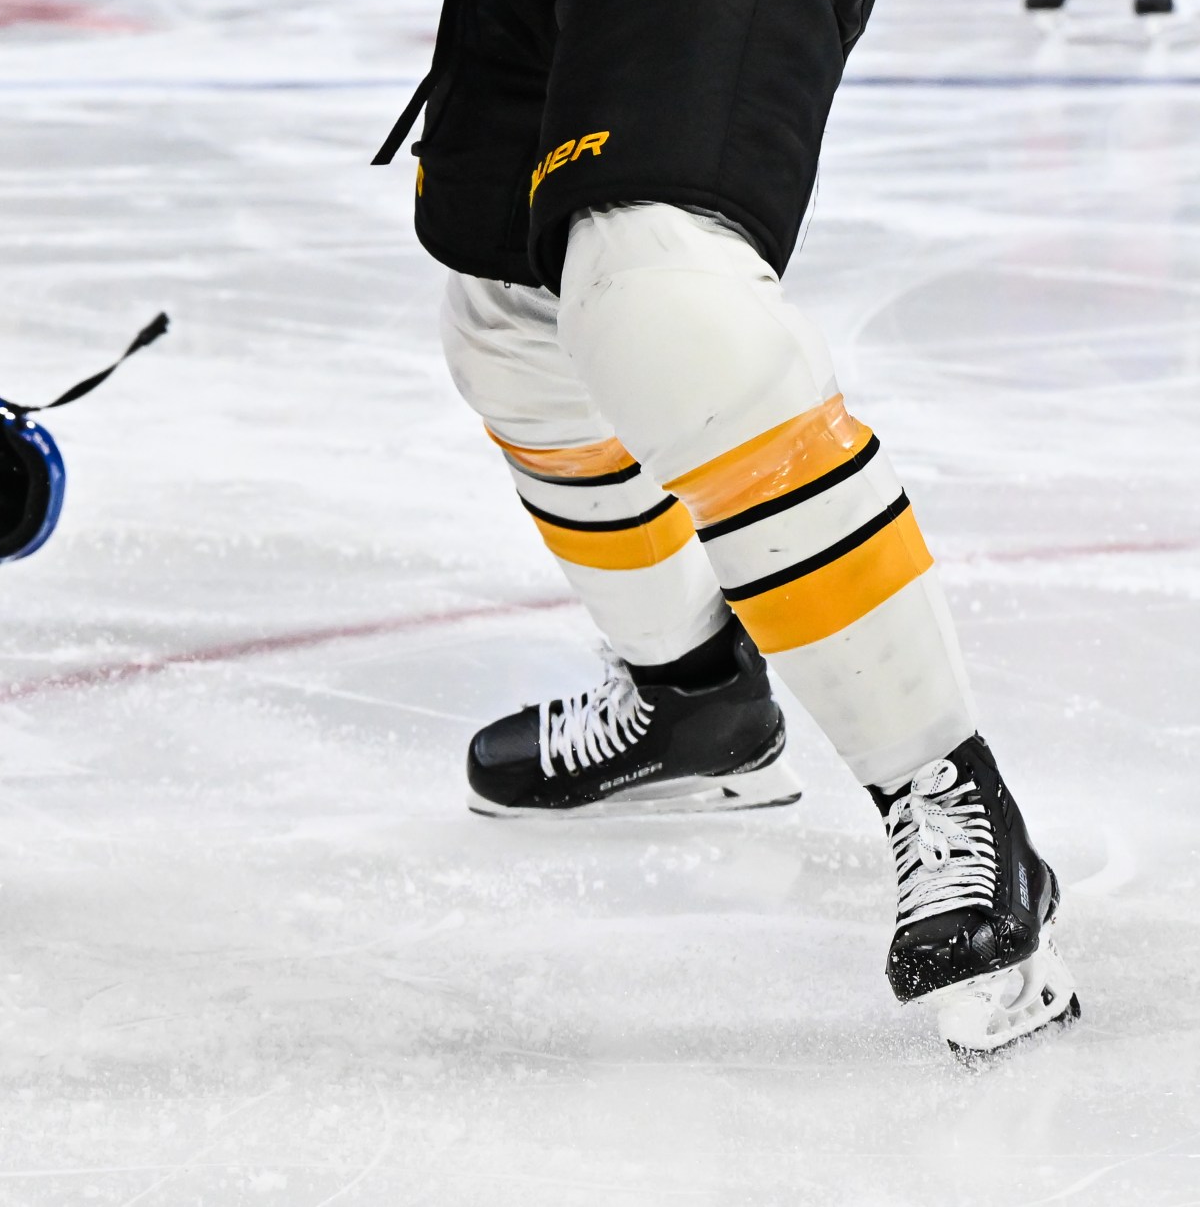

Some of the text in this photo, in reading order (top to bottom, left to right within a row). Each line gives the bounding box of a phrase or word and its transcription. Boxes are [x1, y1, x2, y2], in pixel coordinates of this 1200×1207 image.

[529, 130, 610, 209] UER
[599, 762, 663, 792] BAUER
[1017, 861, 1031, 912] BAUER
